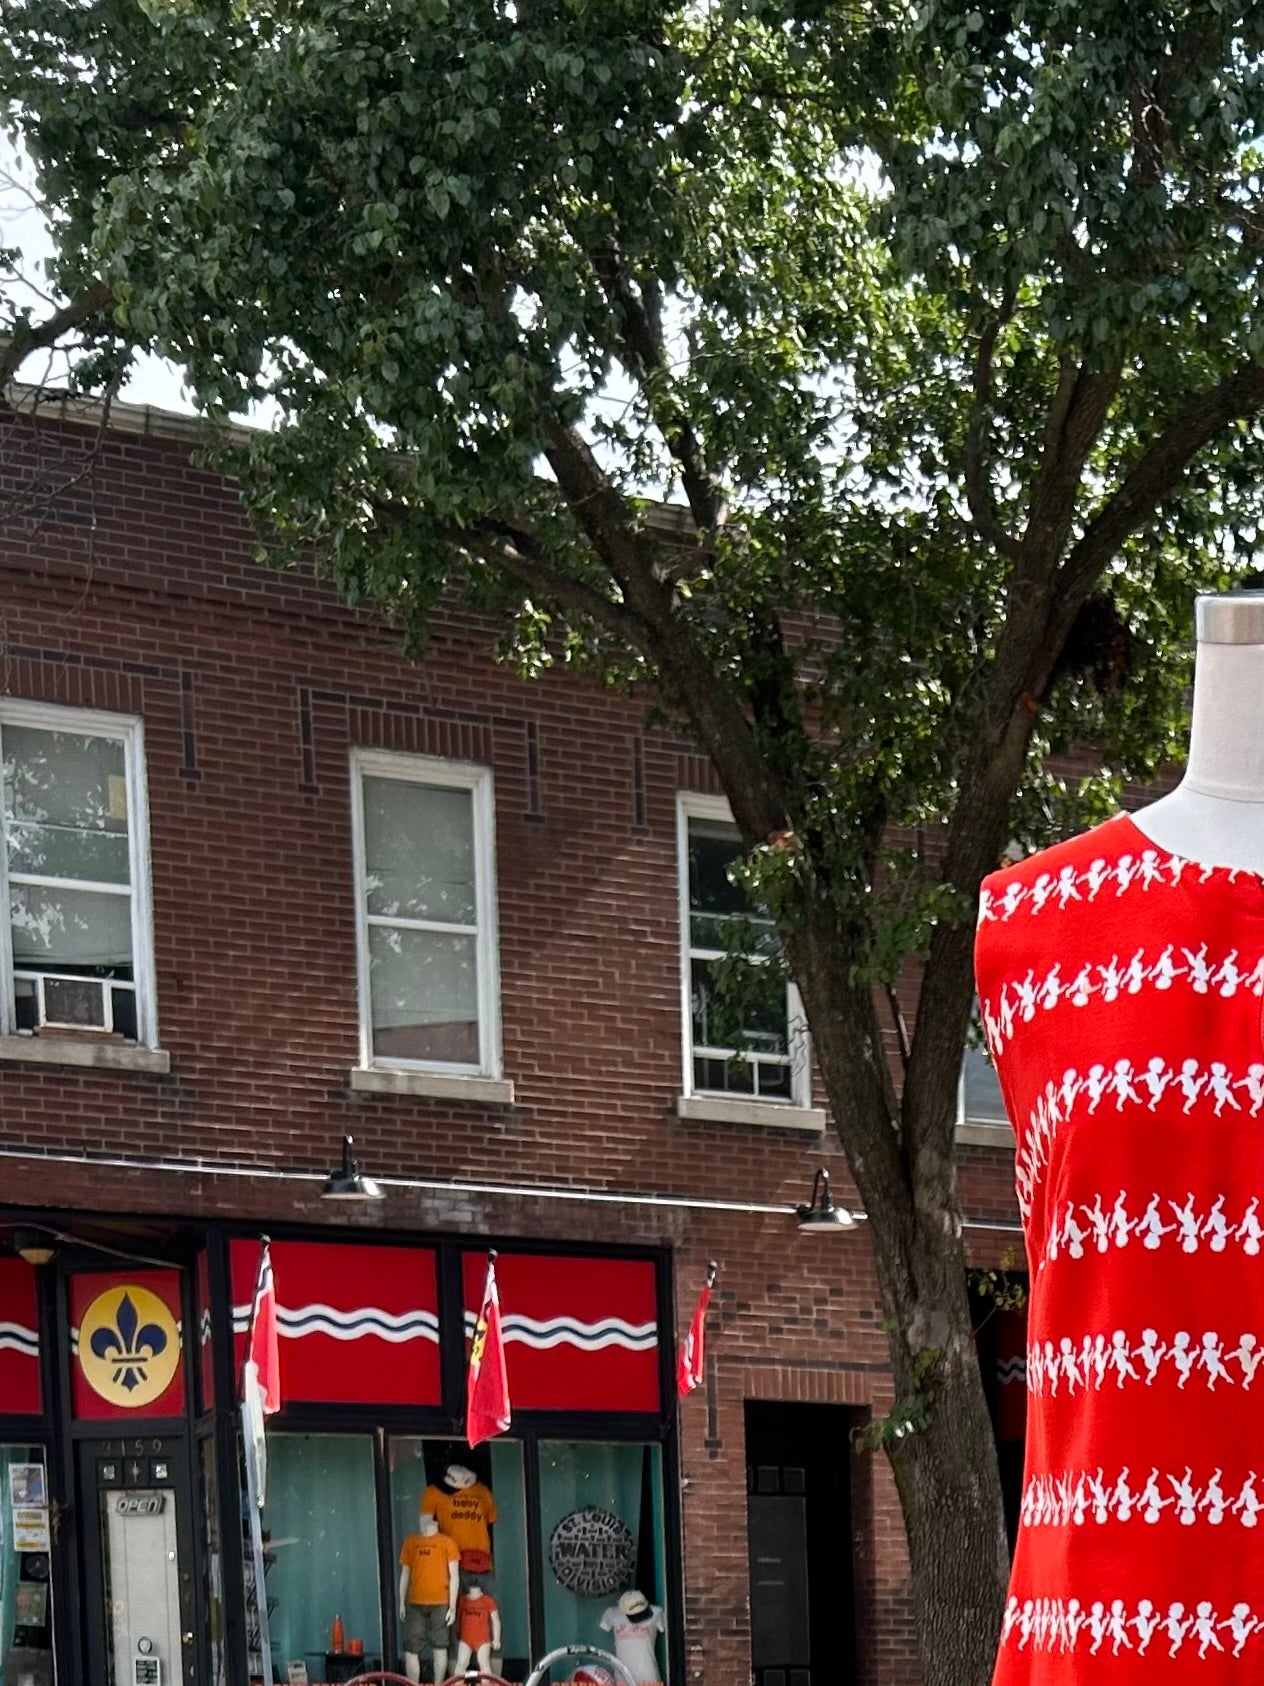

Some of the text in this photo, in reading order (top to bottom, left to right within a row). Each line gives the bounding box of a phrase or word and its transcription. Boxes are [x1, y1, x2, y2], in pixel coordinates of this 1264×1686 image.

[102, 1439, 162, 1457] 3159
[118, 1499, 158, 1513] OPEN
[453, 1498, 480, 1510] baby
[451, 1510, 482, 1523] daddy
[582, 1512, 621, 1536] LOUIS
[556, 1541, 632, 1560] WATER
[561, 1565, 630, 1594] DIVISION
